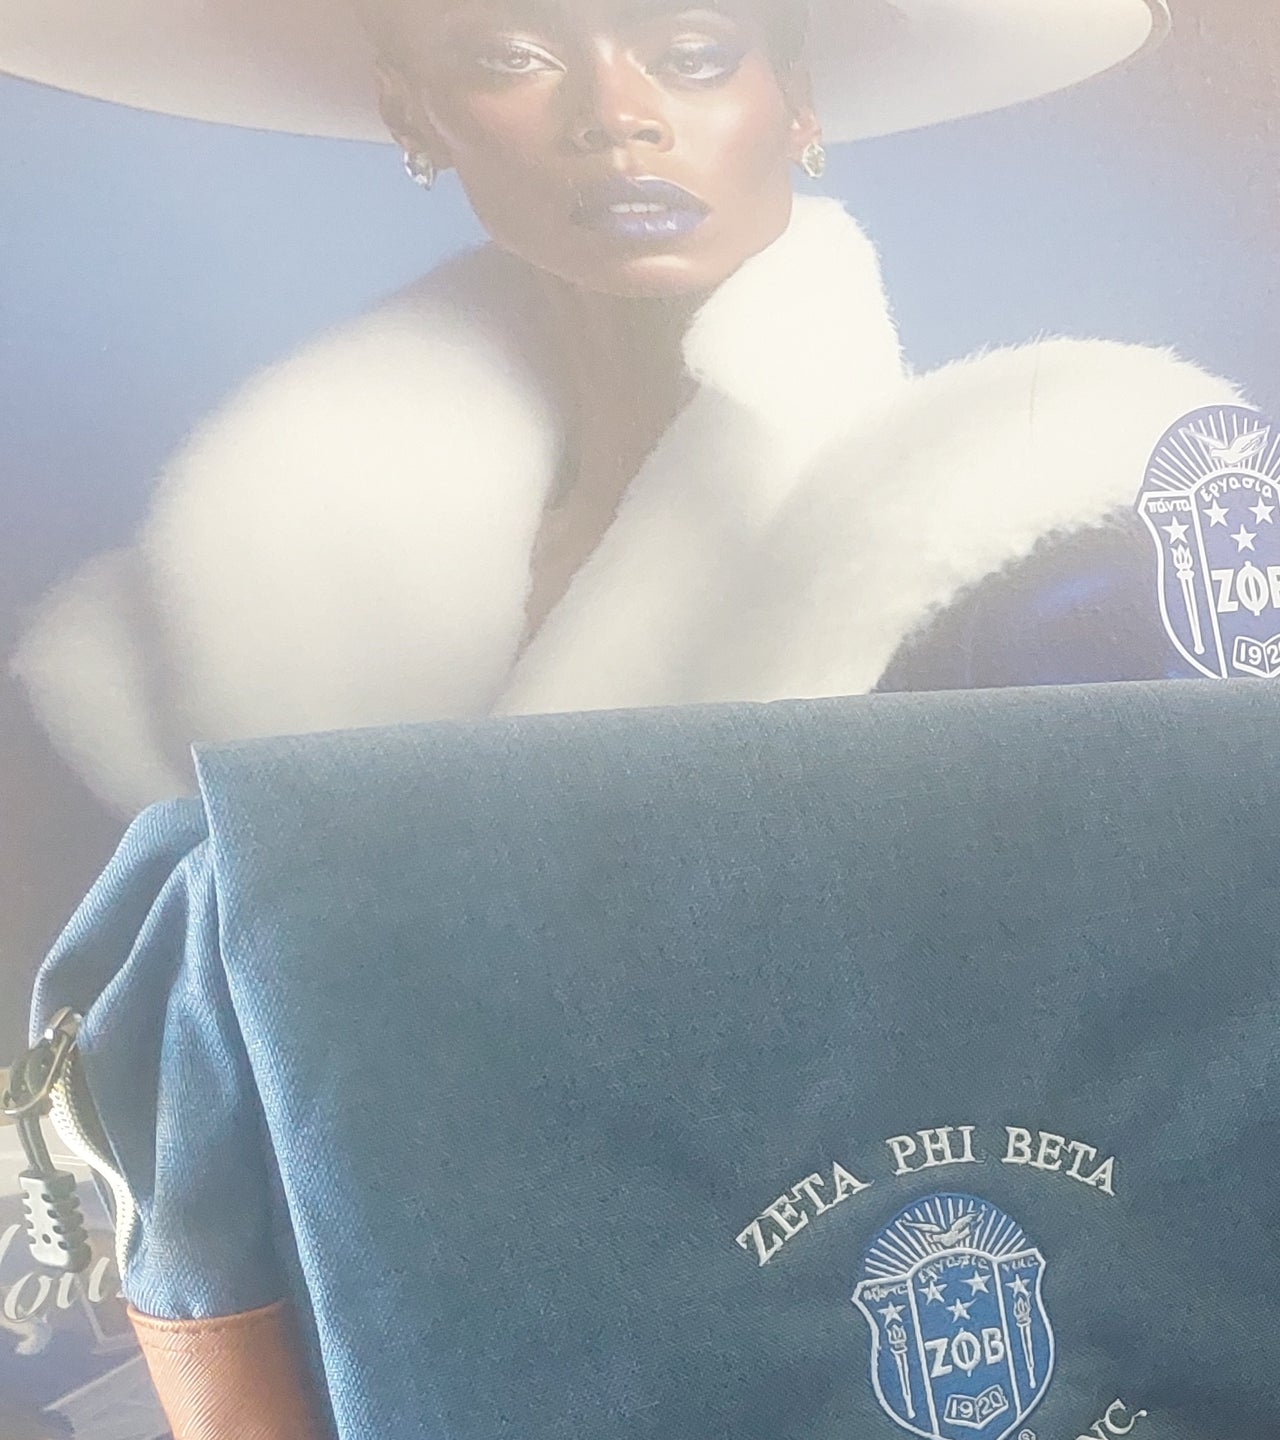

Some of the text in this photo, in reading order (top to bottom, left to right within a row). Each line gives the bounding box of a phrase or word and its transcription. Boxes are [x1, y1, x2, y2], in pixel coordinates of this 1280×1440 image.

[735, 1125, 1116, 1267] ZETA PHI BETA
[950, 1390, 1004, 1419] 1920
